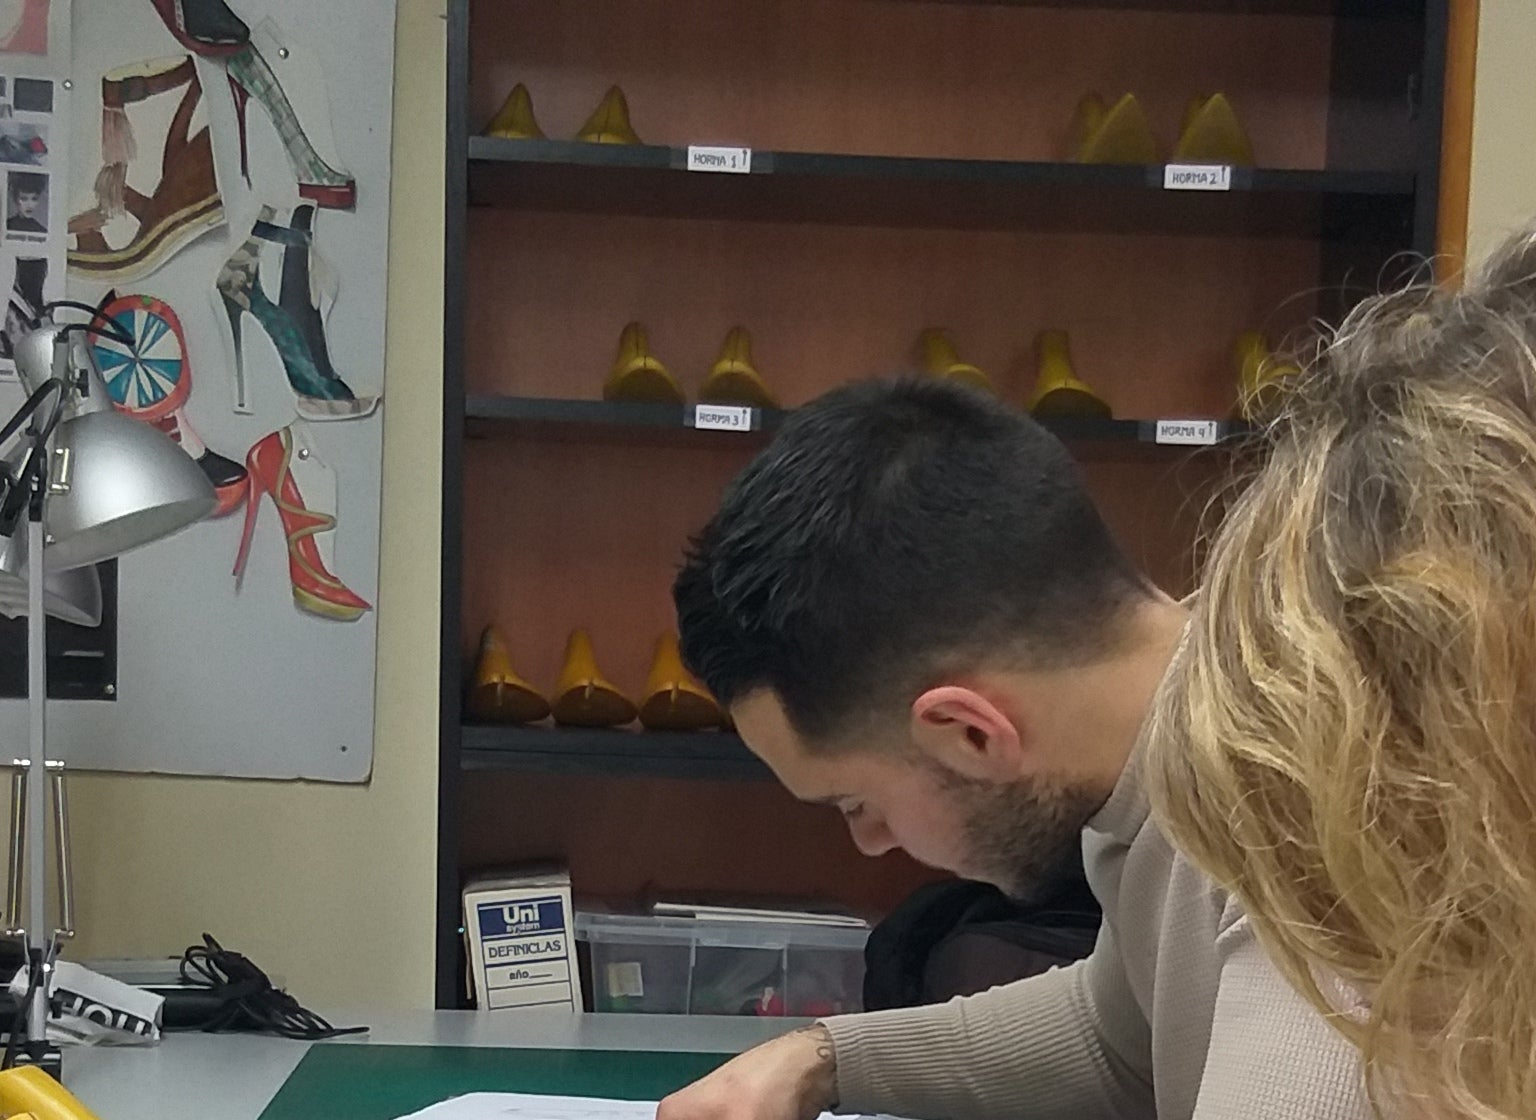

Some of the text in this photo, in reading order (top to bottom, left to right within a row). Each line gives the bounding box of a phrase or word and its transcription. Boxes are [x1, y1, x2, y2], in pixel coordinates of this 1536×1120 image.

[694, 154, 726, 166] HORMA
[1173, 173, 1216, 184] HORMA 2
[699, 412, 738, 426] HORMA 3
[1161, 426, 1195, 437] HORMA
[503, 903, 540, 924] Uni
[488, 940, 562, 958] DEFINICLAS
